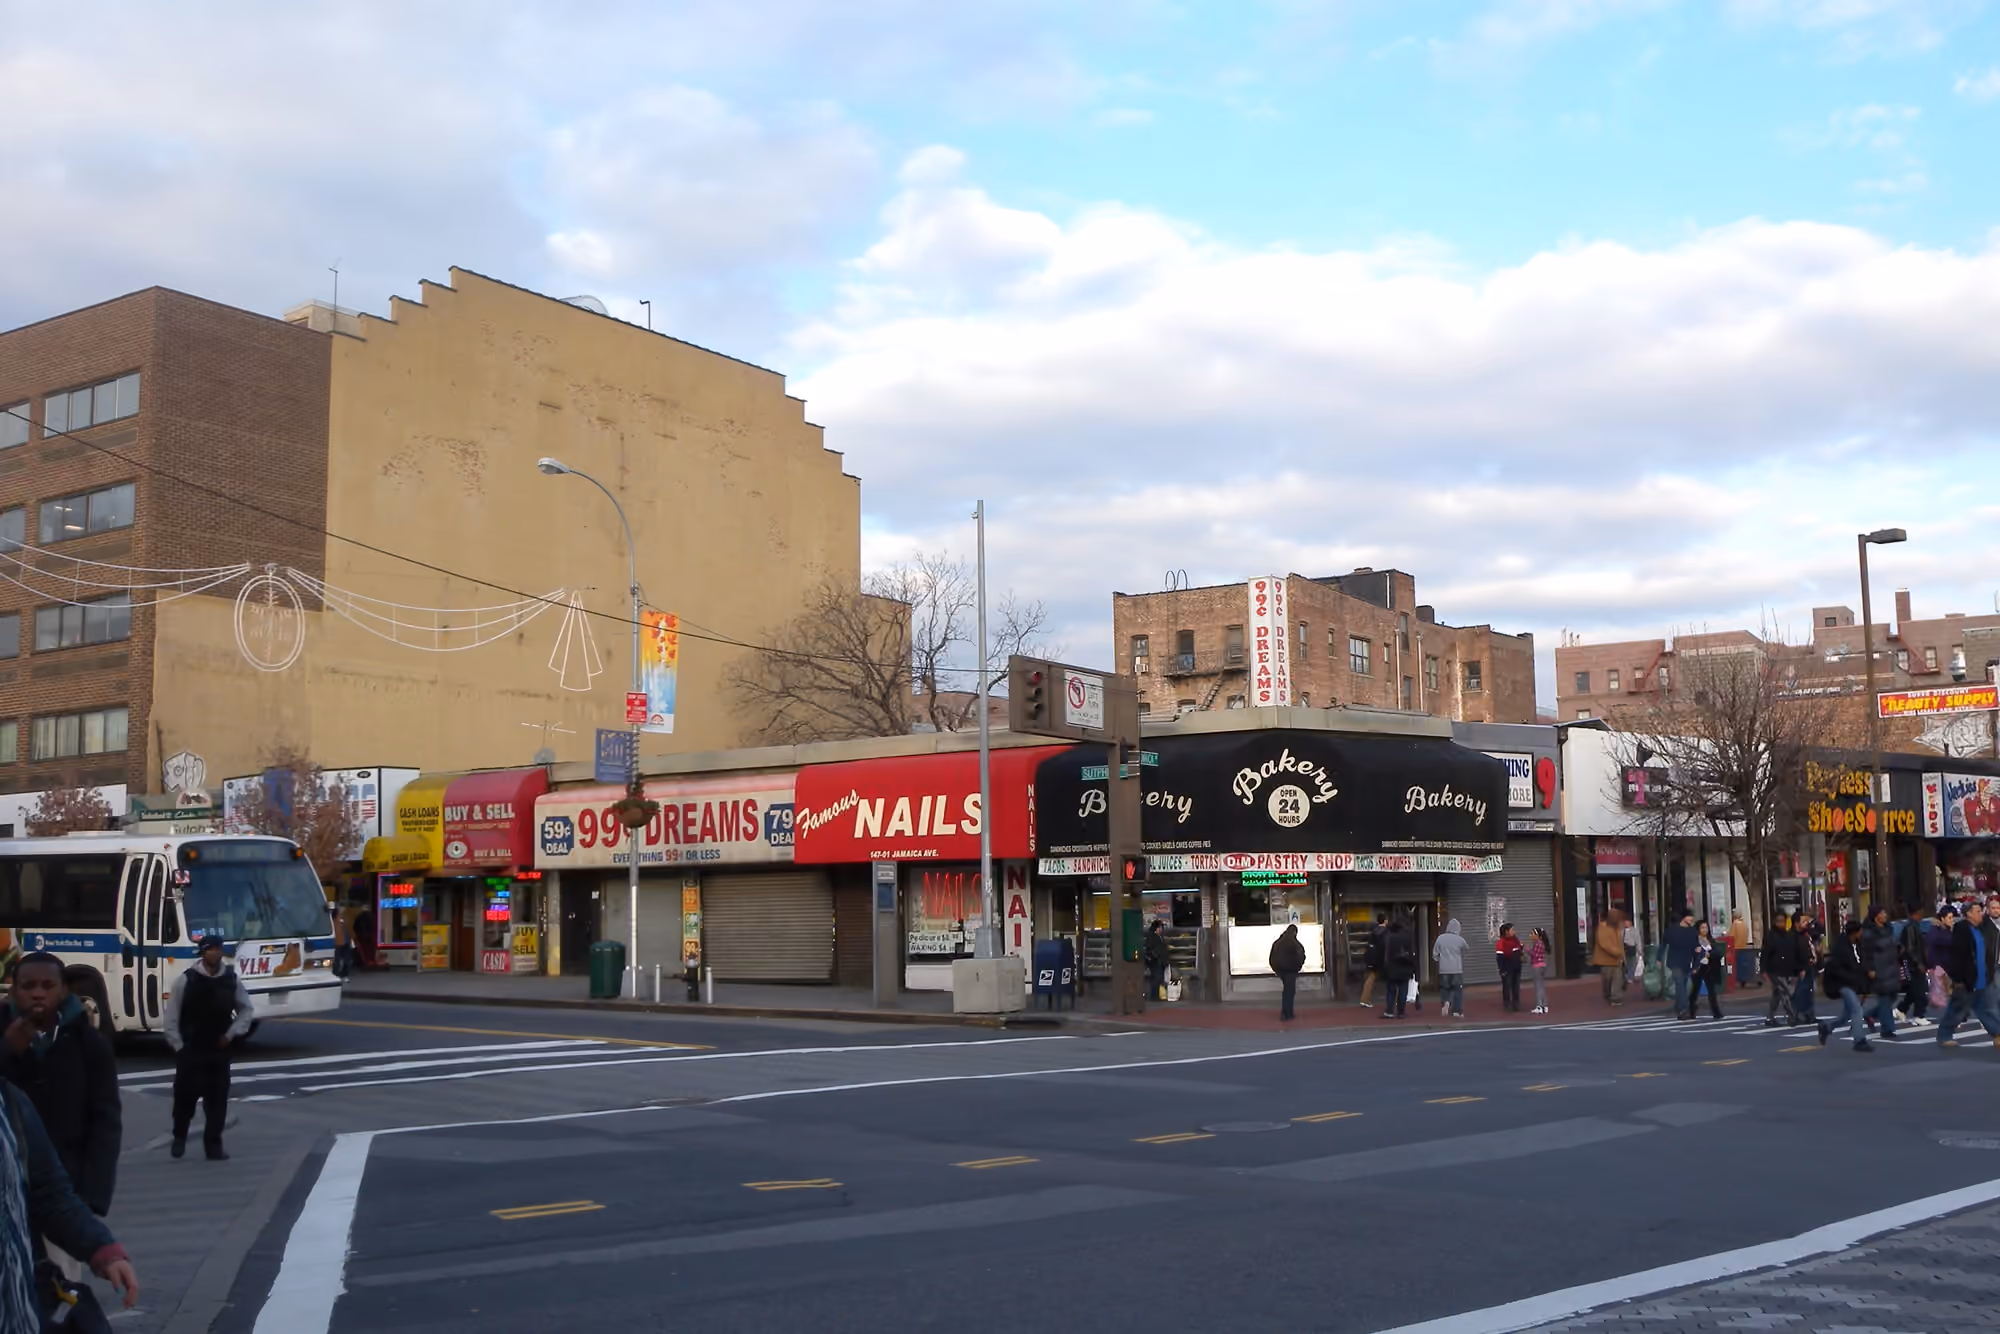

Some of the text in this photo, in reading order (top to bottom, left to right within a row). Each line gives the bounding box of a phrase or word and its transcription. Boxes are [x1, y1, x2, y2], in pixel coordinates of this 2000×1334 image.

[1256, 626, 1272, 702] DREAMS
[1276, 626, 1287, 702] DREAMS
[1888, 692, 1997, 712] BEAUTY SUPPLY
[1233, 748, 1339, 805] Bakery
[1280, 789, 1297, 797] OPEN
[400, 806, 440, 818] CASH LOANS
[444, 803, 515, 821] BUY & SELL
[1078, 788, 1193, 823] Bery
[1278, 799, 1300, 814] 24
[1404, 784, 1487, 826] Bakery
[796, 789, 860, 838] Famous
[854, 793, 982, 839] NAILS
[1027, 784, 1036, 852] NAILS
[1278, 816, 1300, 824] HOURS
[645, 798, 759, 847] DREAMS
[546, 843, 569, 854] DEAL
[686, 850, 699, 861] OR
[701, 849, 721, 860] LESS
[870, 850, 890, 859] 147-01
[892, 850, 922, 858] JAMAICA
[1043, 859, 1065, 873] TACOS
[1157, 855, 1182, 870] JUICES
[1190, 854, 1219, 869] TORTAS
[1257, 854, 1308, 869] PASTRY
[1316, 853, 1352, 869] SHOP
[923, 872, 982, 921] NAILS
[515, 926, 536, 937] BUY
[910, 934, 941, 942] Pedicure
[512, 945, 537, 954] SELL
[910, 944, 937, 952] WAXING
[483, 952, 506, 970] CASH
